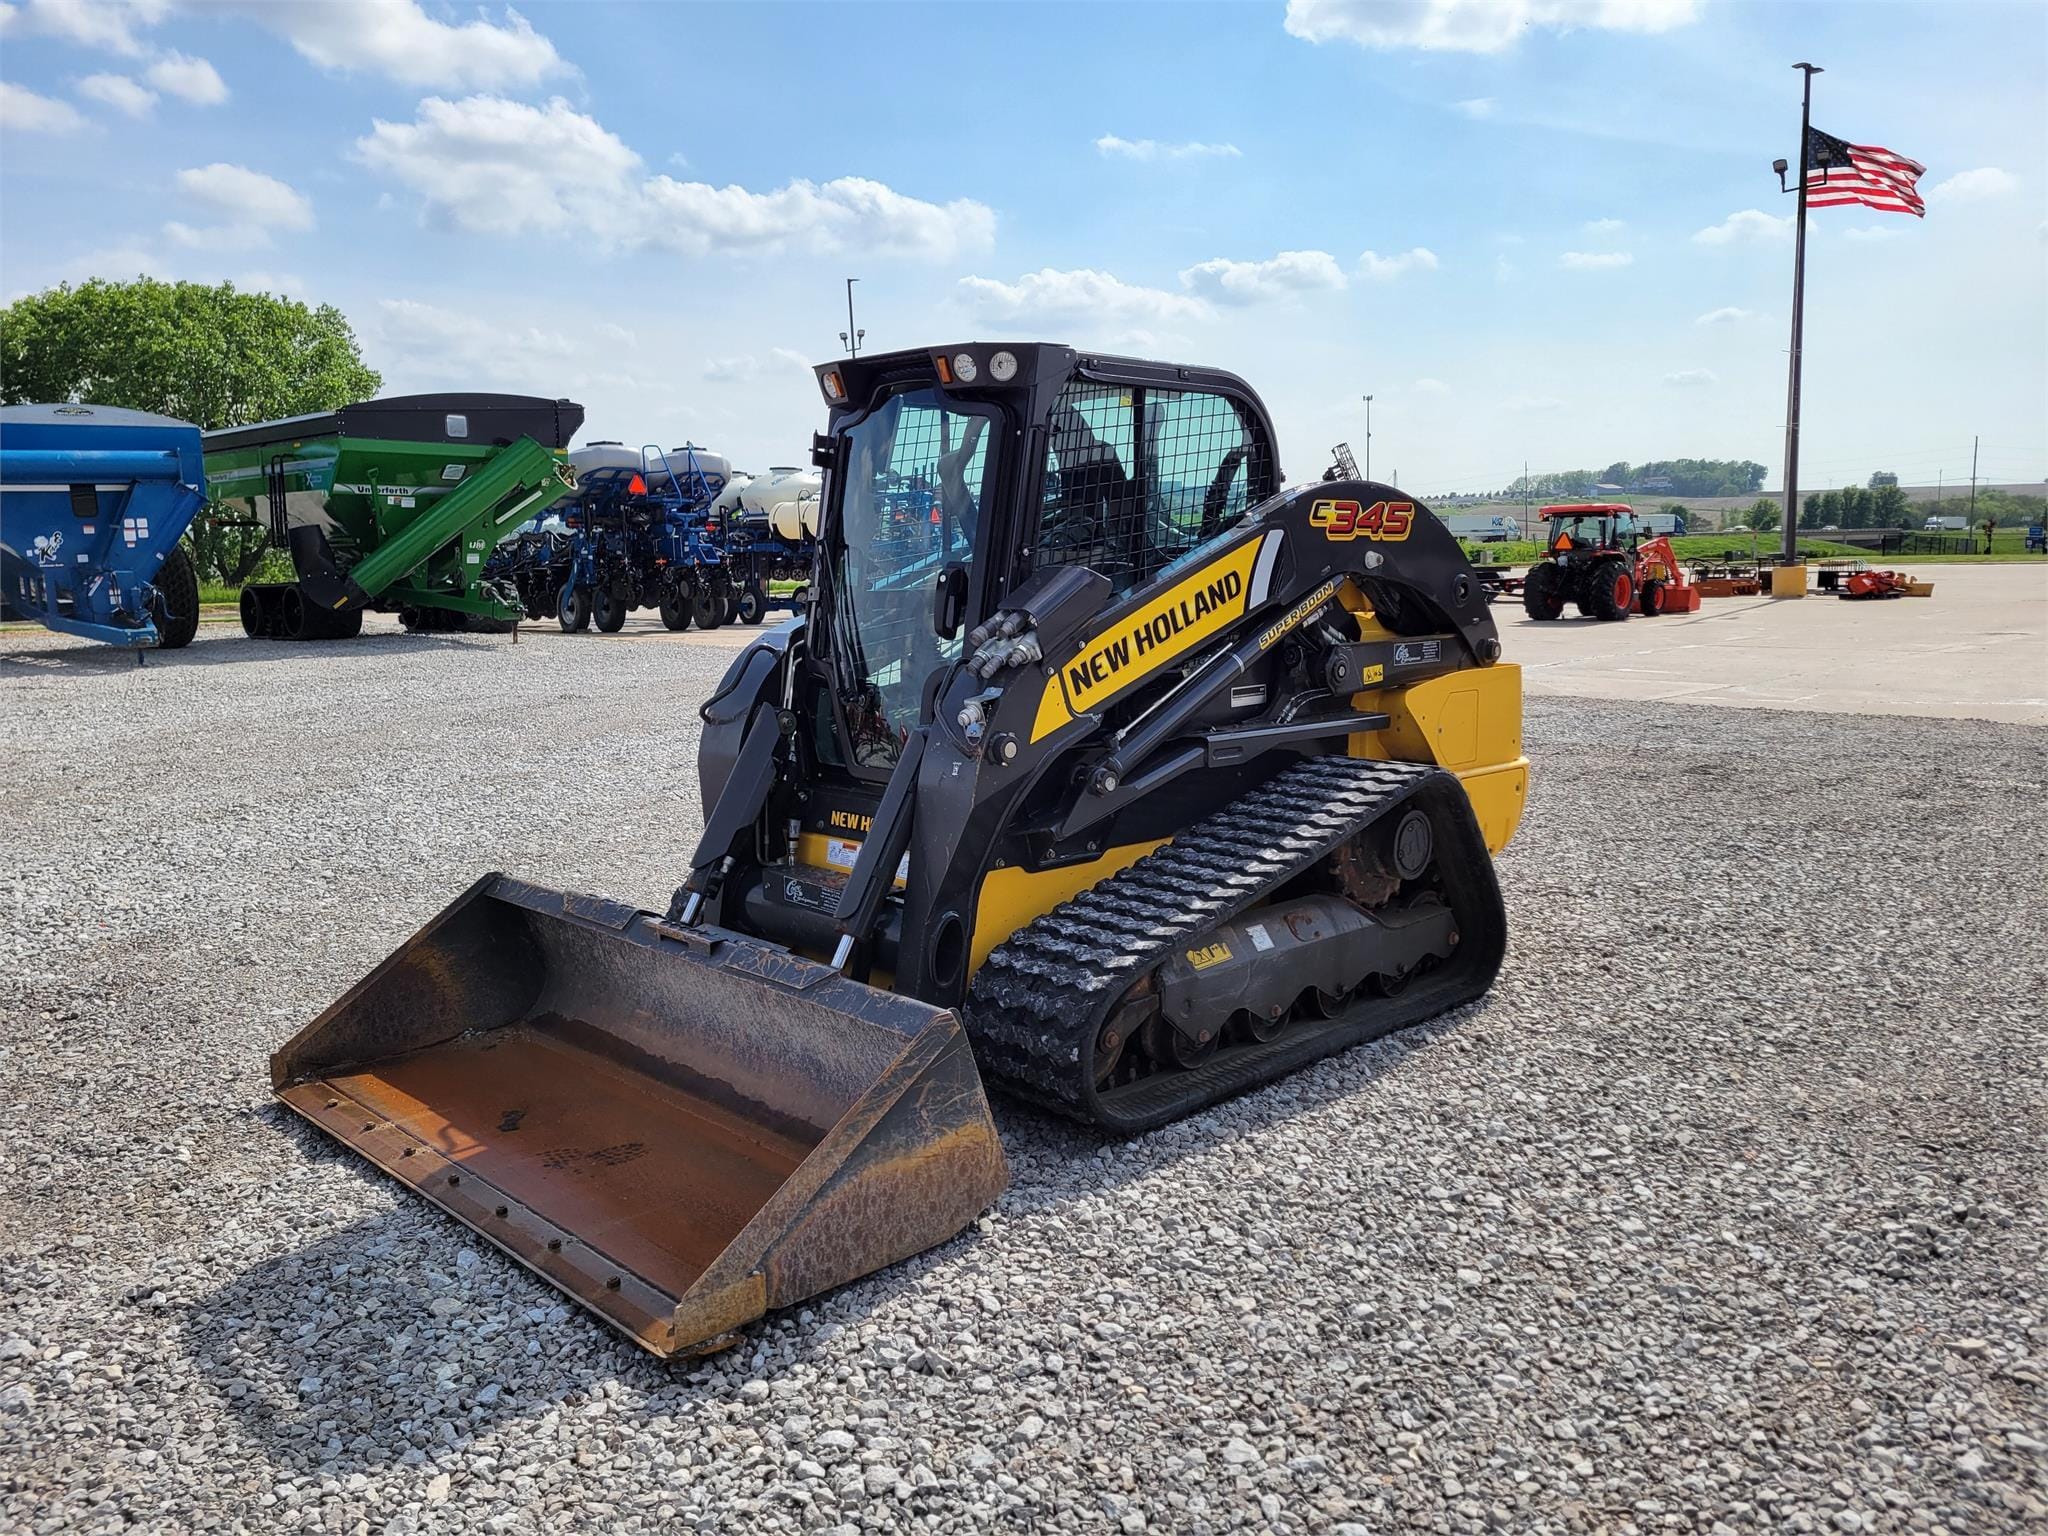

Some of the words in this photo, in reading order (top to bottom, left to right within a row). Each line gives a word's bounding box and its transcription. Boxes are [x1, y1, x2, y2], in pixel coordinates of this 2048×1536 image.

[1309, 500, 1414, 541] C345
[1069, 636, 1130, 697] NEW
[1133, 570, 1242, 656] HOLLAND
[1258, 609, 1299, 650] SUPER
[1299, 581, 1334, 616] BOOM
[830, 810, 859, 830] NEW
[861, 815, 874, 832] H
